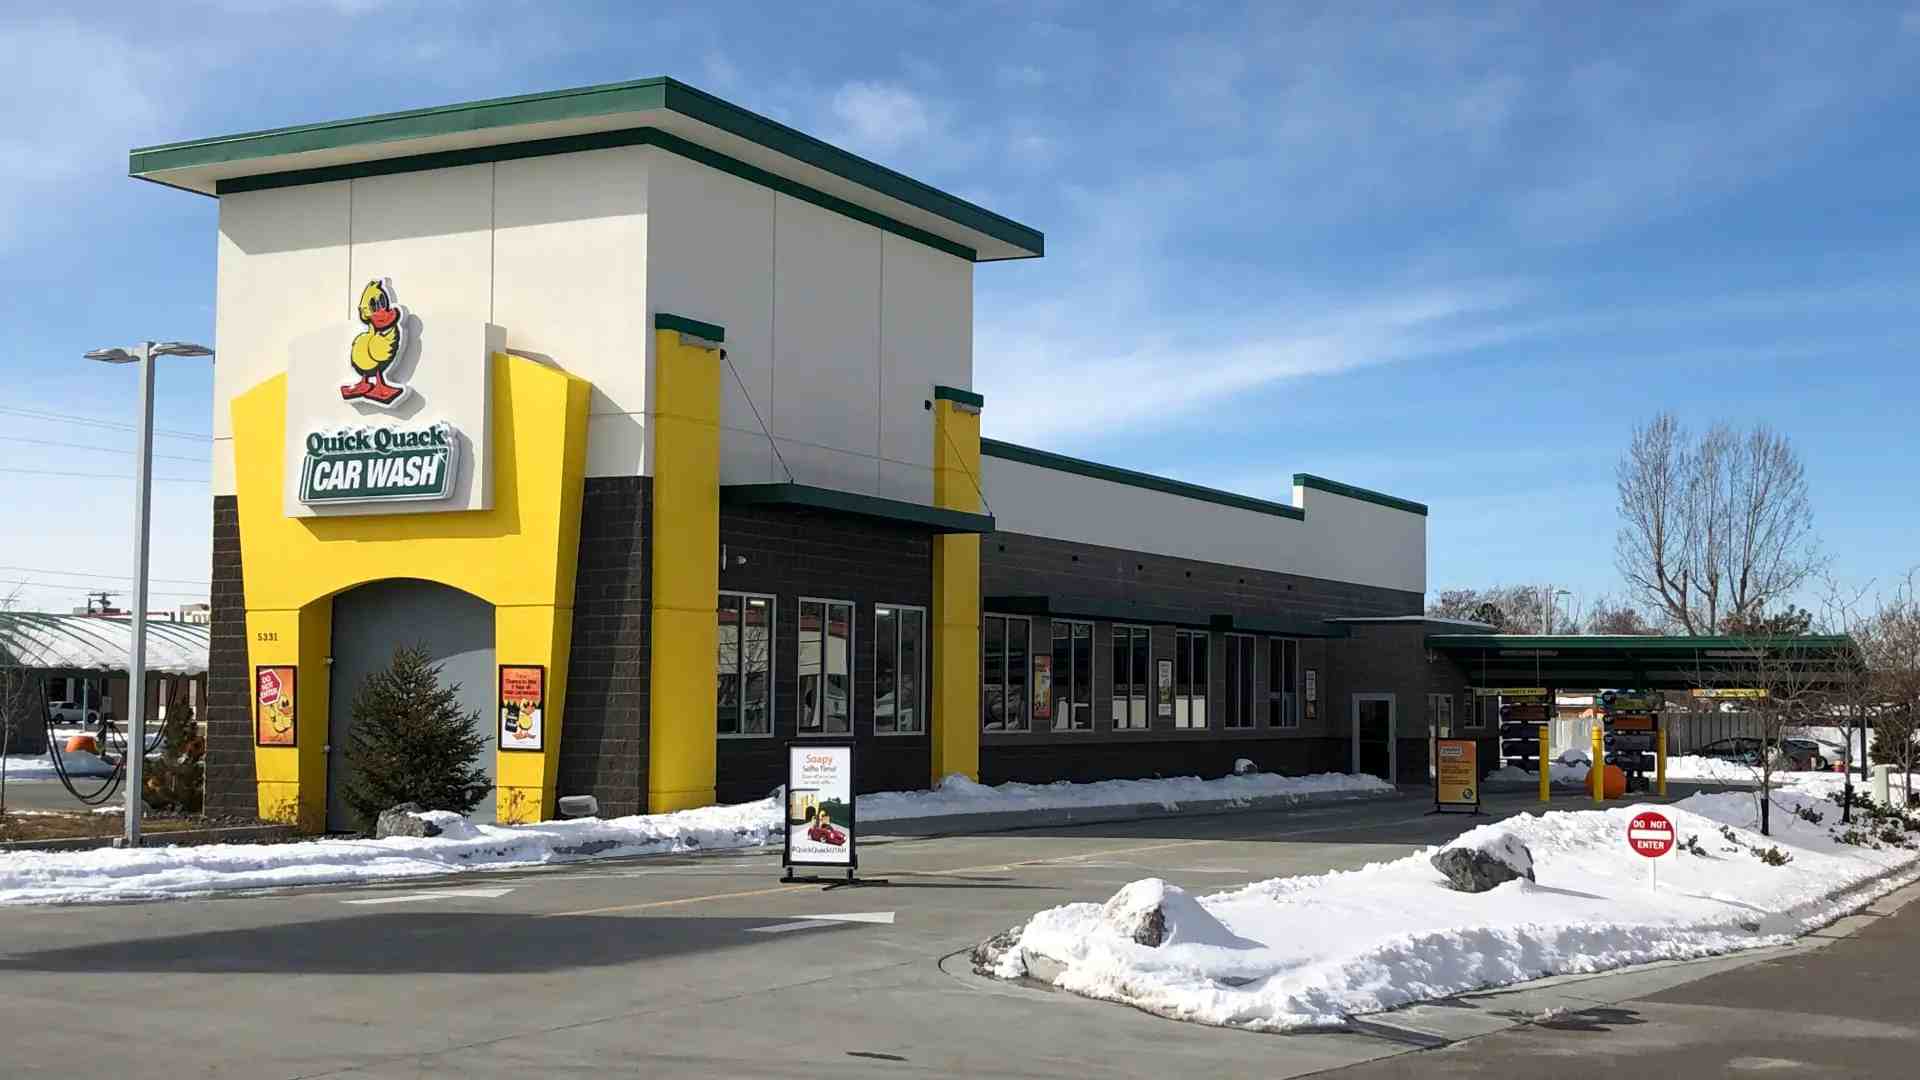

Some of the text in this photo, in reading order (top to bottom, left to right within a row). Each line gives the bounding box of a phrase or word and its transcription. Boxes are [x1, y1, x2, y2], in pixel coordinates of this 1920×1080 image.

[306, 424, 446, 457] Quick Quack
[313, 454, 439, 492] CAR WASH
[257, 632, 278, 641] 5331
[806, 753, 833, 765] Soapy
[1633, 820, 1667, 829] DO NOT
[1637, 840, 1664, 849] ENTER
